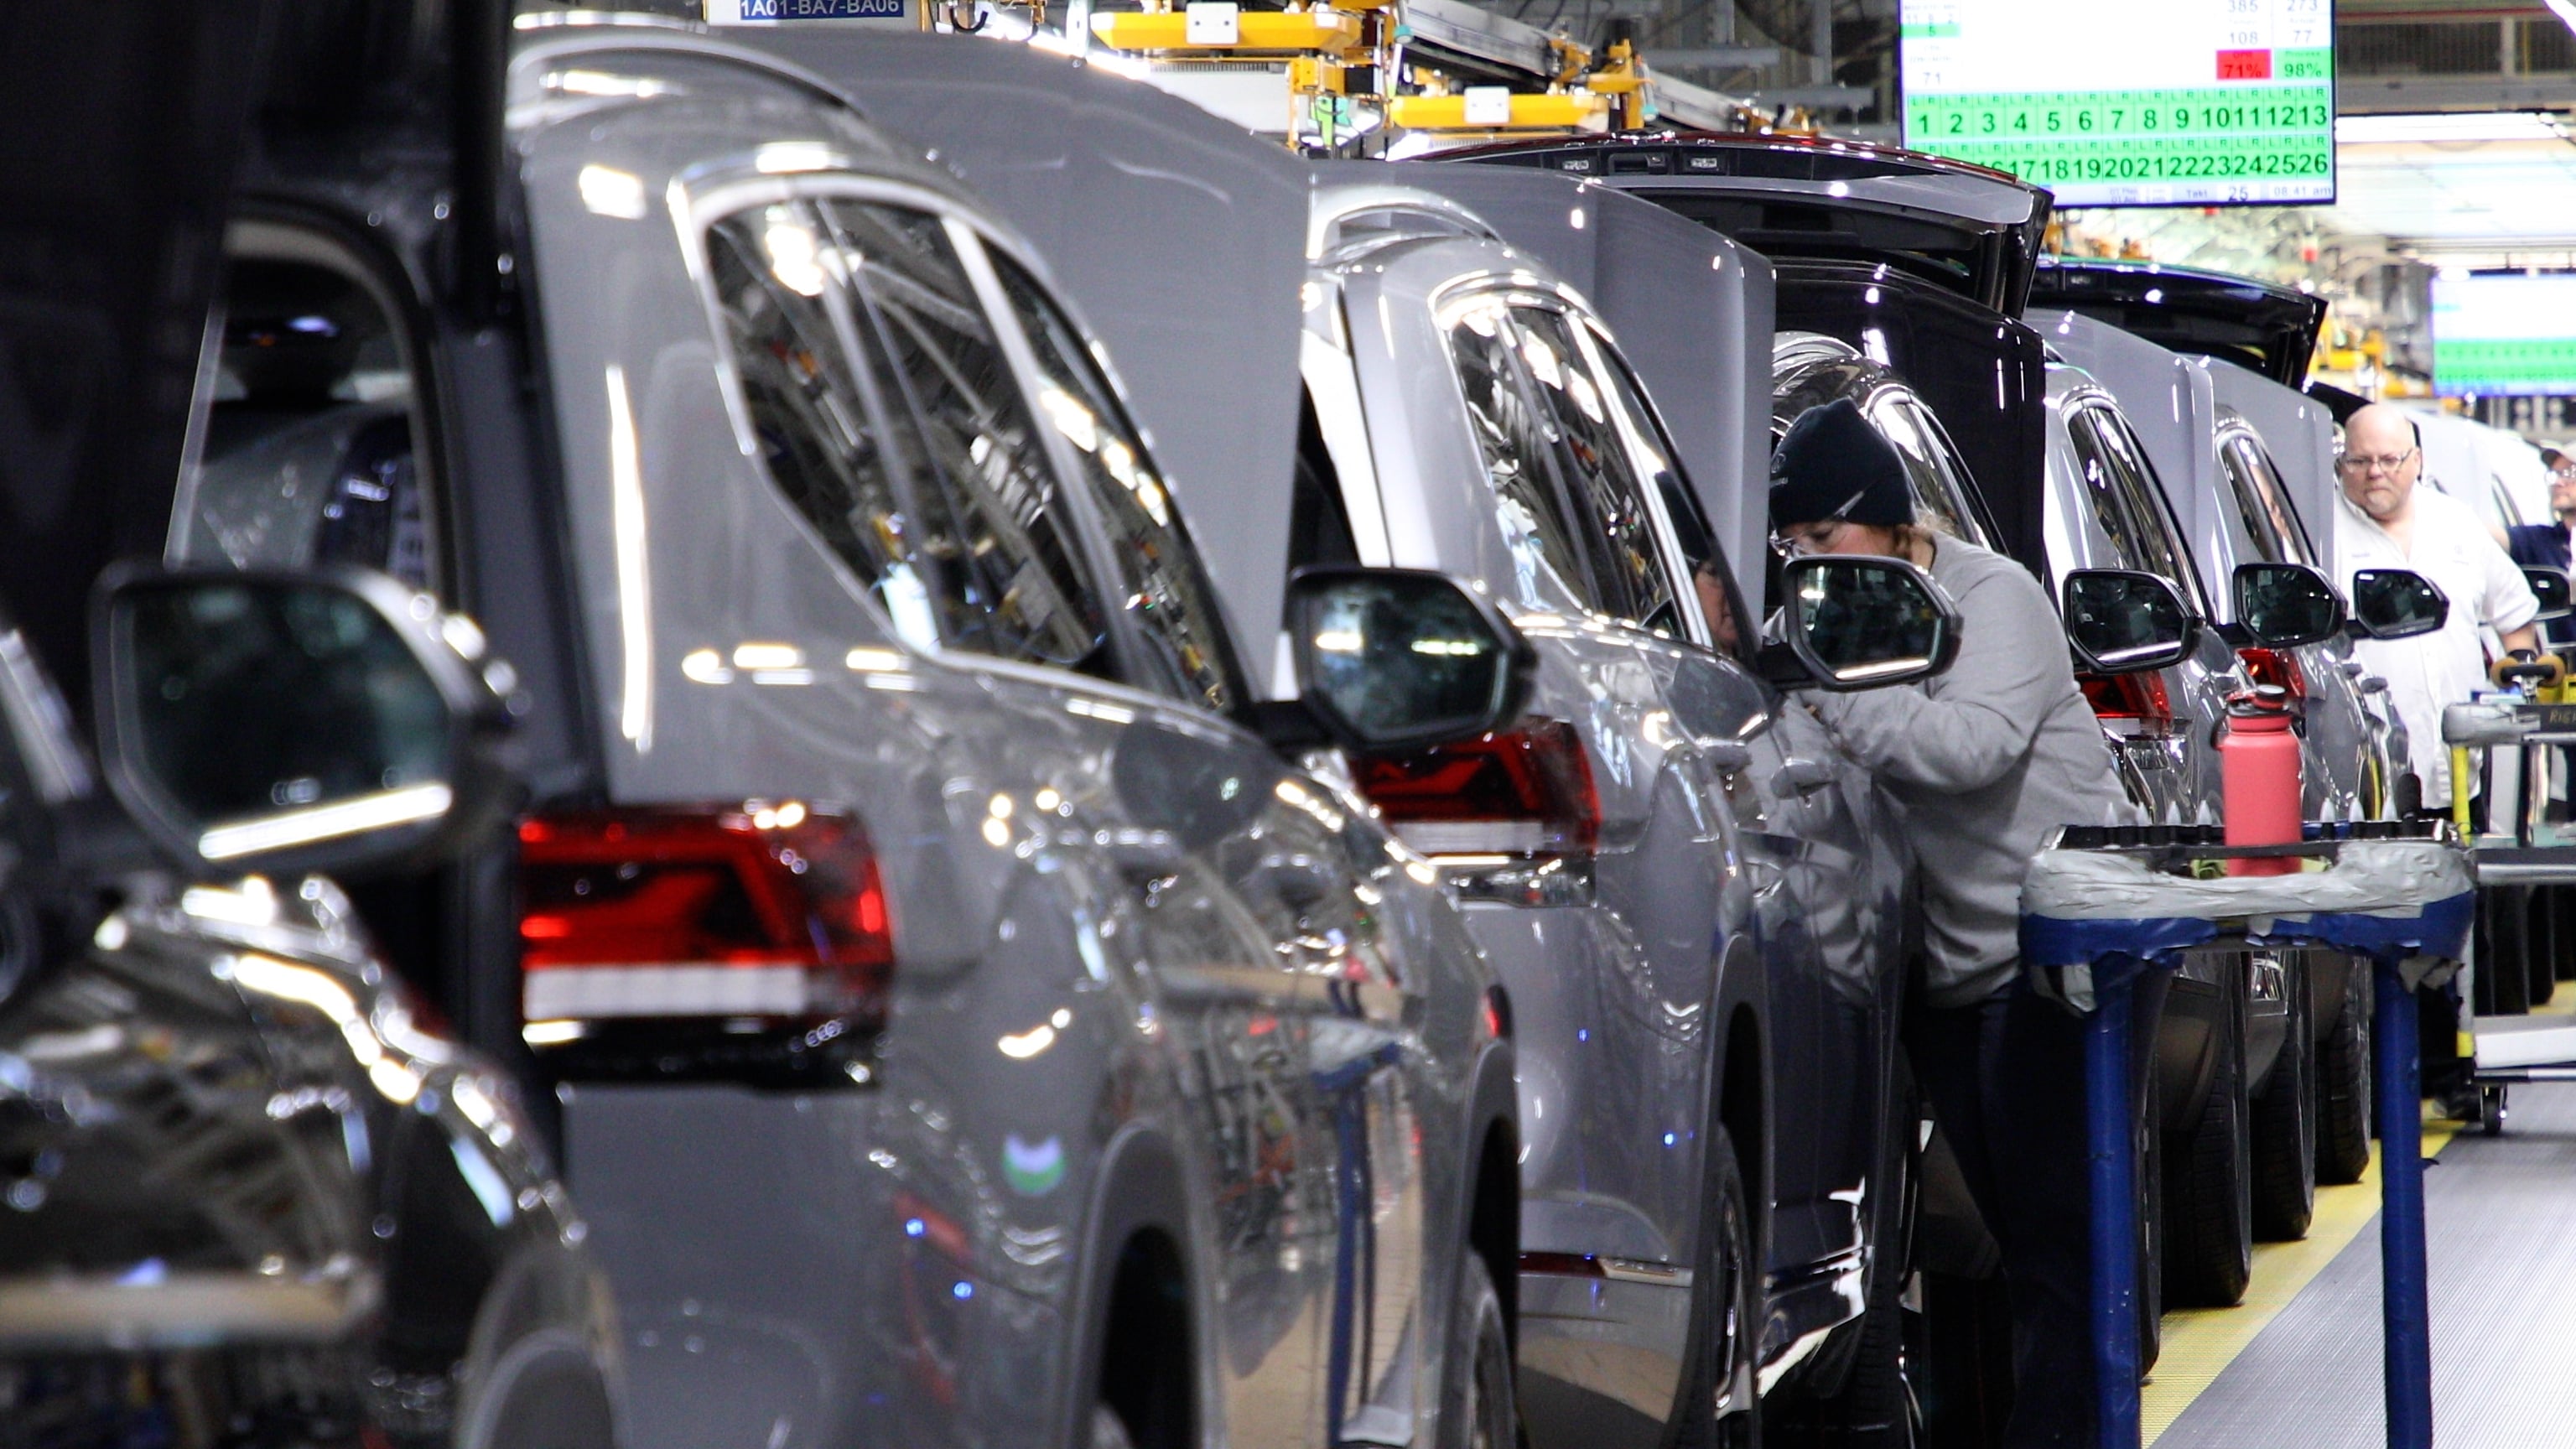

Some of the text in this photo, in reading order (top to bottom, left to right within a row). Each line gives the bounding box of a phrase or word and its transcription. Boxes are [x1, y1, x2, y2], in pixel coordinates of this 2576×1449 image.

[2228, 0, 2258, 13] 385
[2287, 0, 2318, 12] 273
[2230, 31, 2258, 45] 108
[2293, 29, 2313, 44] 77
[2224, 64, 2262, 79] 71%
[2284, 63, 2322, 78] 98%
[1923, 71, 1941, 86] 71
[1919, 106, 2327, 132] 1 2 3 4 5 6 7 8 9 10 11 12 13
[2041, 160, 2068, 179] 18
[2074, 159, 2101, 178] 19
[2104, 158, 2133, 178] 20
[2137, 158, 2162, 176] 21
[2169, 158, 2197, 176] 22
[2201, 156, 2231, 175] 23
[2234, 156, 2262, 174] 24
[2267, 155, 2296, 174] 25
[2298, 154, 2328, 173] 26
[2228, 187, 2247, 201] 25
